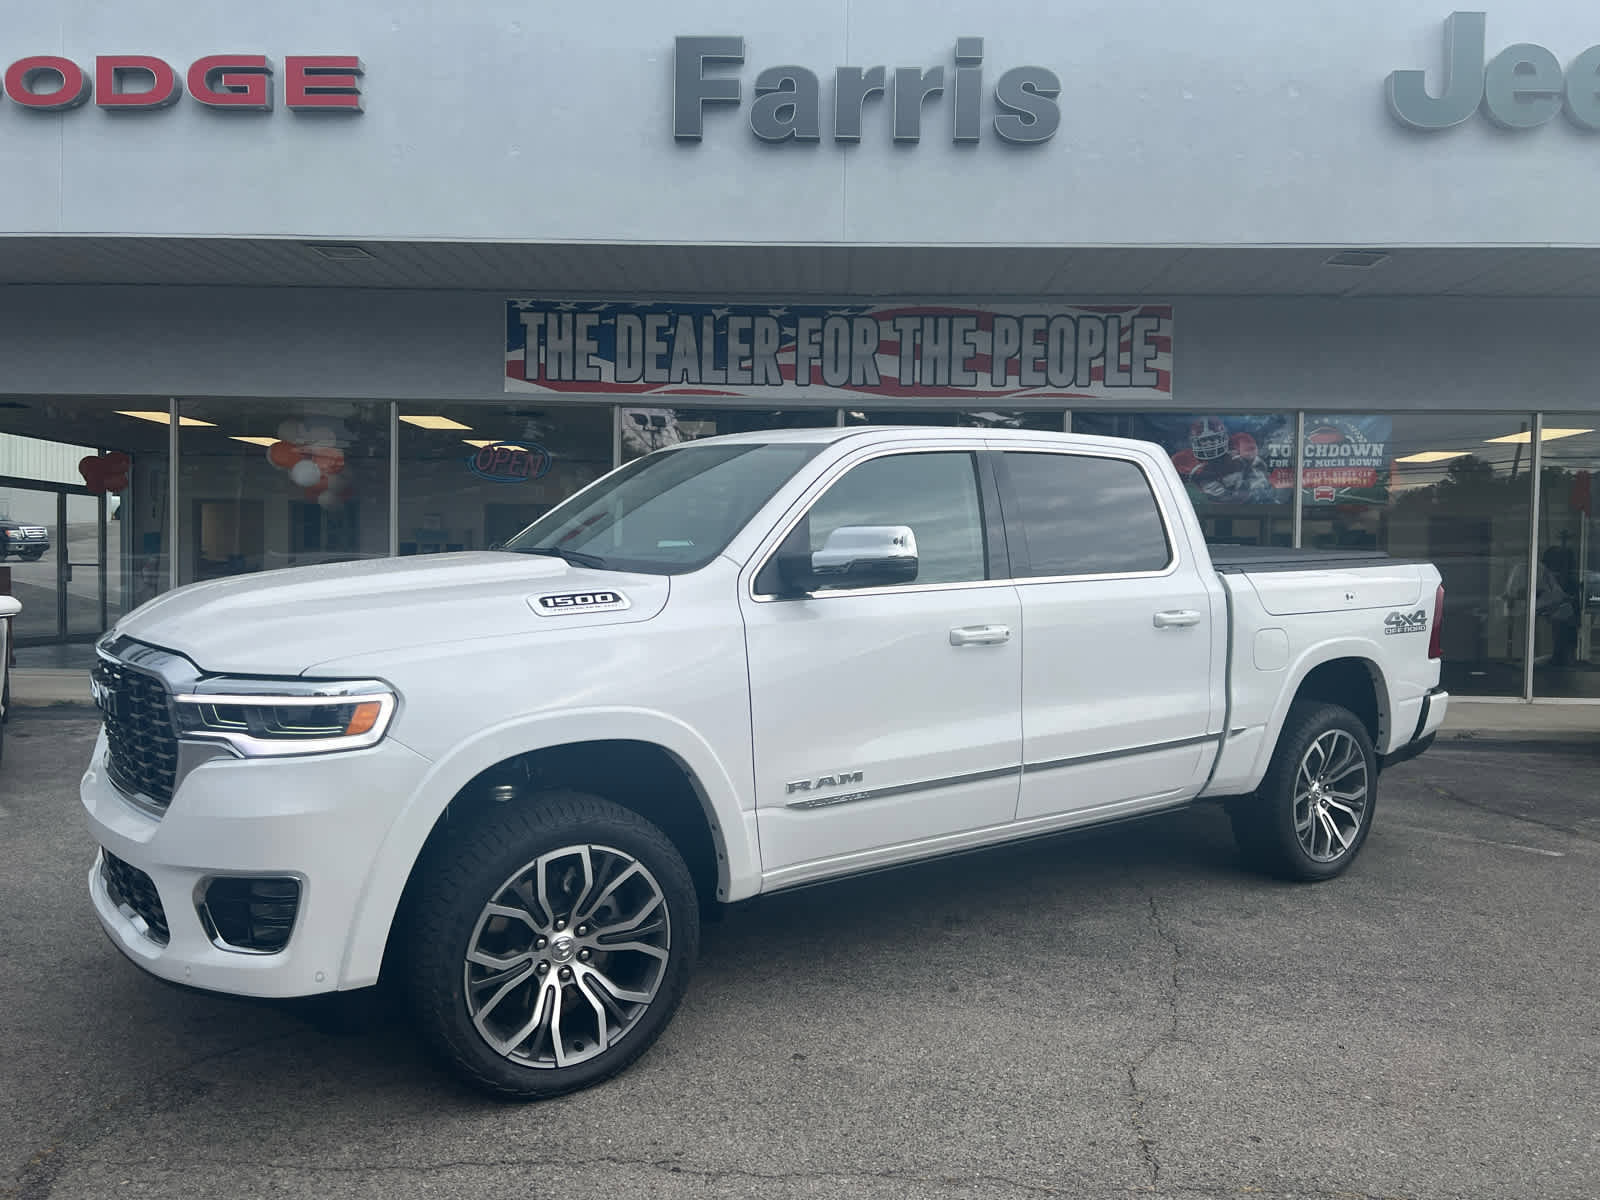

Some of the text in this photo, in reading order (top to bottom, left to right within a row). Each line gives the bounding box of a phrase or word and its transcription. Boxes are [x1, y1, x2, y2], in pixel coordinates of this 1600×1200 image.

[0, 55, 364, 113] ODGE
[673, 36, 1061, 143] Farris
[520, 311, 1160, 388] THE DEALER FOR THE PEOPLE
[476, 445, 544, 477] OPEN
[1268, 443, 1385, 458] TOCHDOWN
[1315, 459, 1345, 467] MUCH
[541, 592, 615, 608] 1500
[785, 769, 864, 794] RAM
